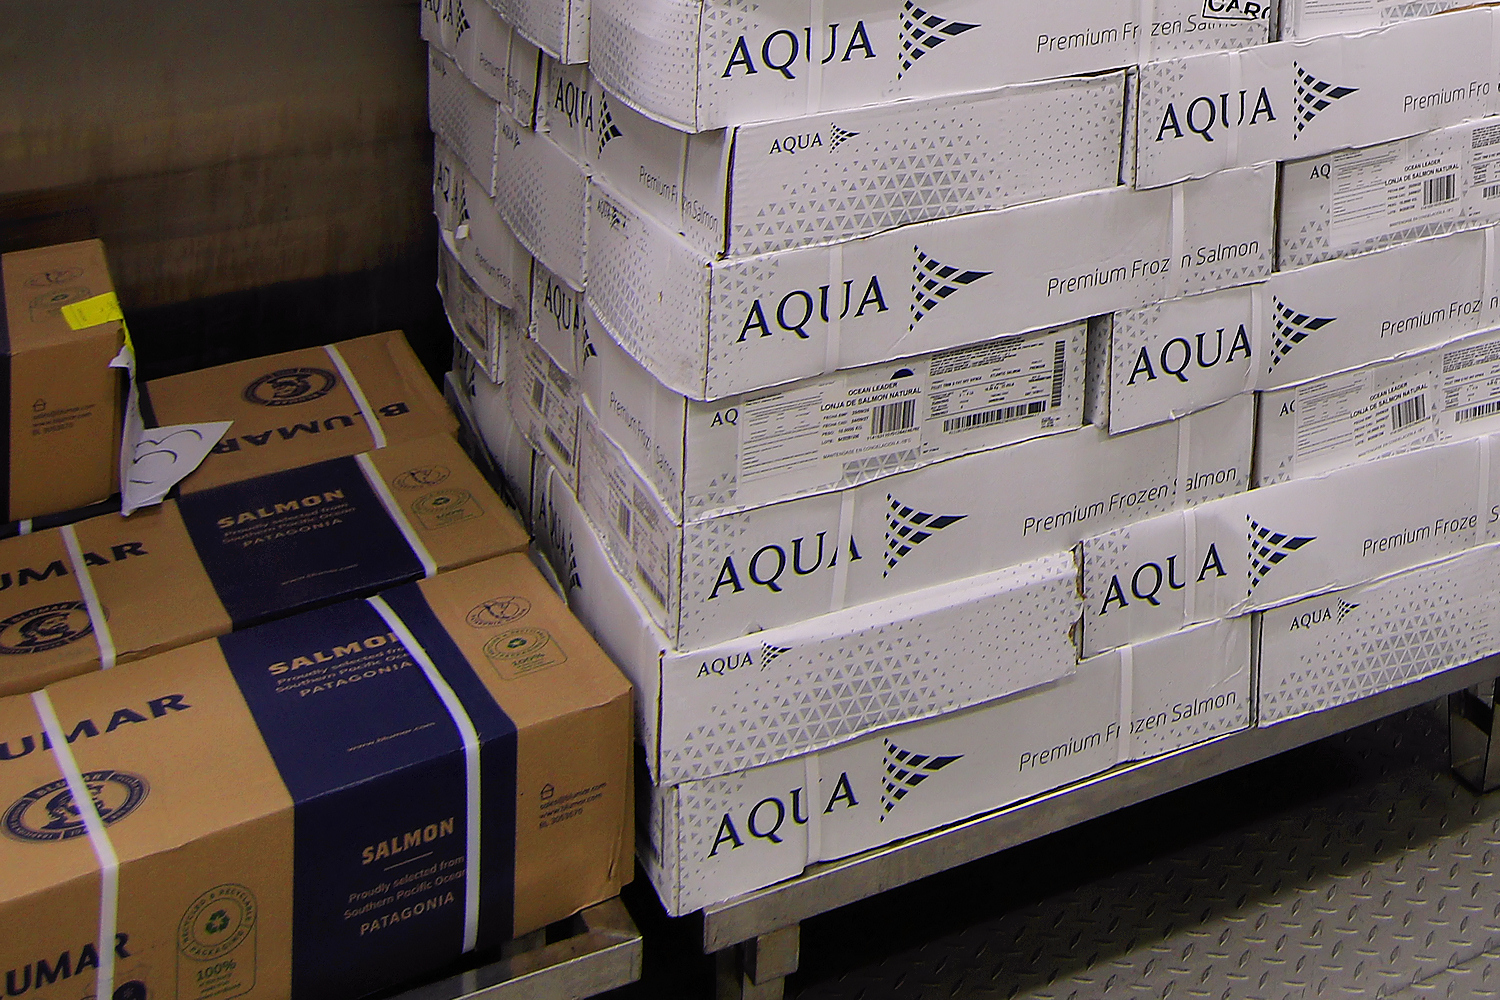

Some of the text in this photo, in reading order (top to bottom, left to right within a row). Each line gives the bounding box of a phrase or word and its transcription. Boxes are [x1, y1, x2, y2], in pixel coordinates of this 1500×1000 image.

[1156, 87, 1276, 142] AQUA
[1403, 85, 1466, 113] Premium
[769, 132, 823, 154] AQUA
[1047, 240, 1259, 296] Premium Frozn Salmon
[1127, 323, 1252, 386] AQUA
[217, 489, 346, 529] SALMON
[1023, 502, 1104, 536] Premium
[1108, 483, 1168, 511] Frozen
[1362, 526, 1430, 557] Premium
[1434, 514, 1477, 538] Froze
[1099, 542, 1227, 617] AQUA
[1290, 608, 1332, 631] AQUA
[300, 661, 413, 697] PATAGONIA
[696, 652, 754, 678] AQUA
[1018, 732, 1101, 772] Premium
[1171, 690, 1236, 723] Salmon
[361, 817, 454, 866] SALMON
[344, 895, 394, 920] Southern
[397, 881, 432, 900] Pacific
[349, 881, 391, 904] Proudly
[393, 864, 437, 888] selected
[360, 891, 455, 936] PATAGONIA
